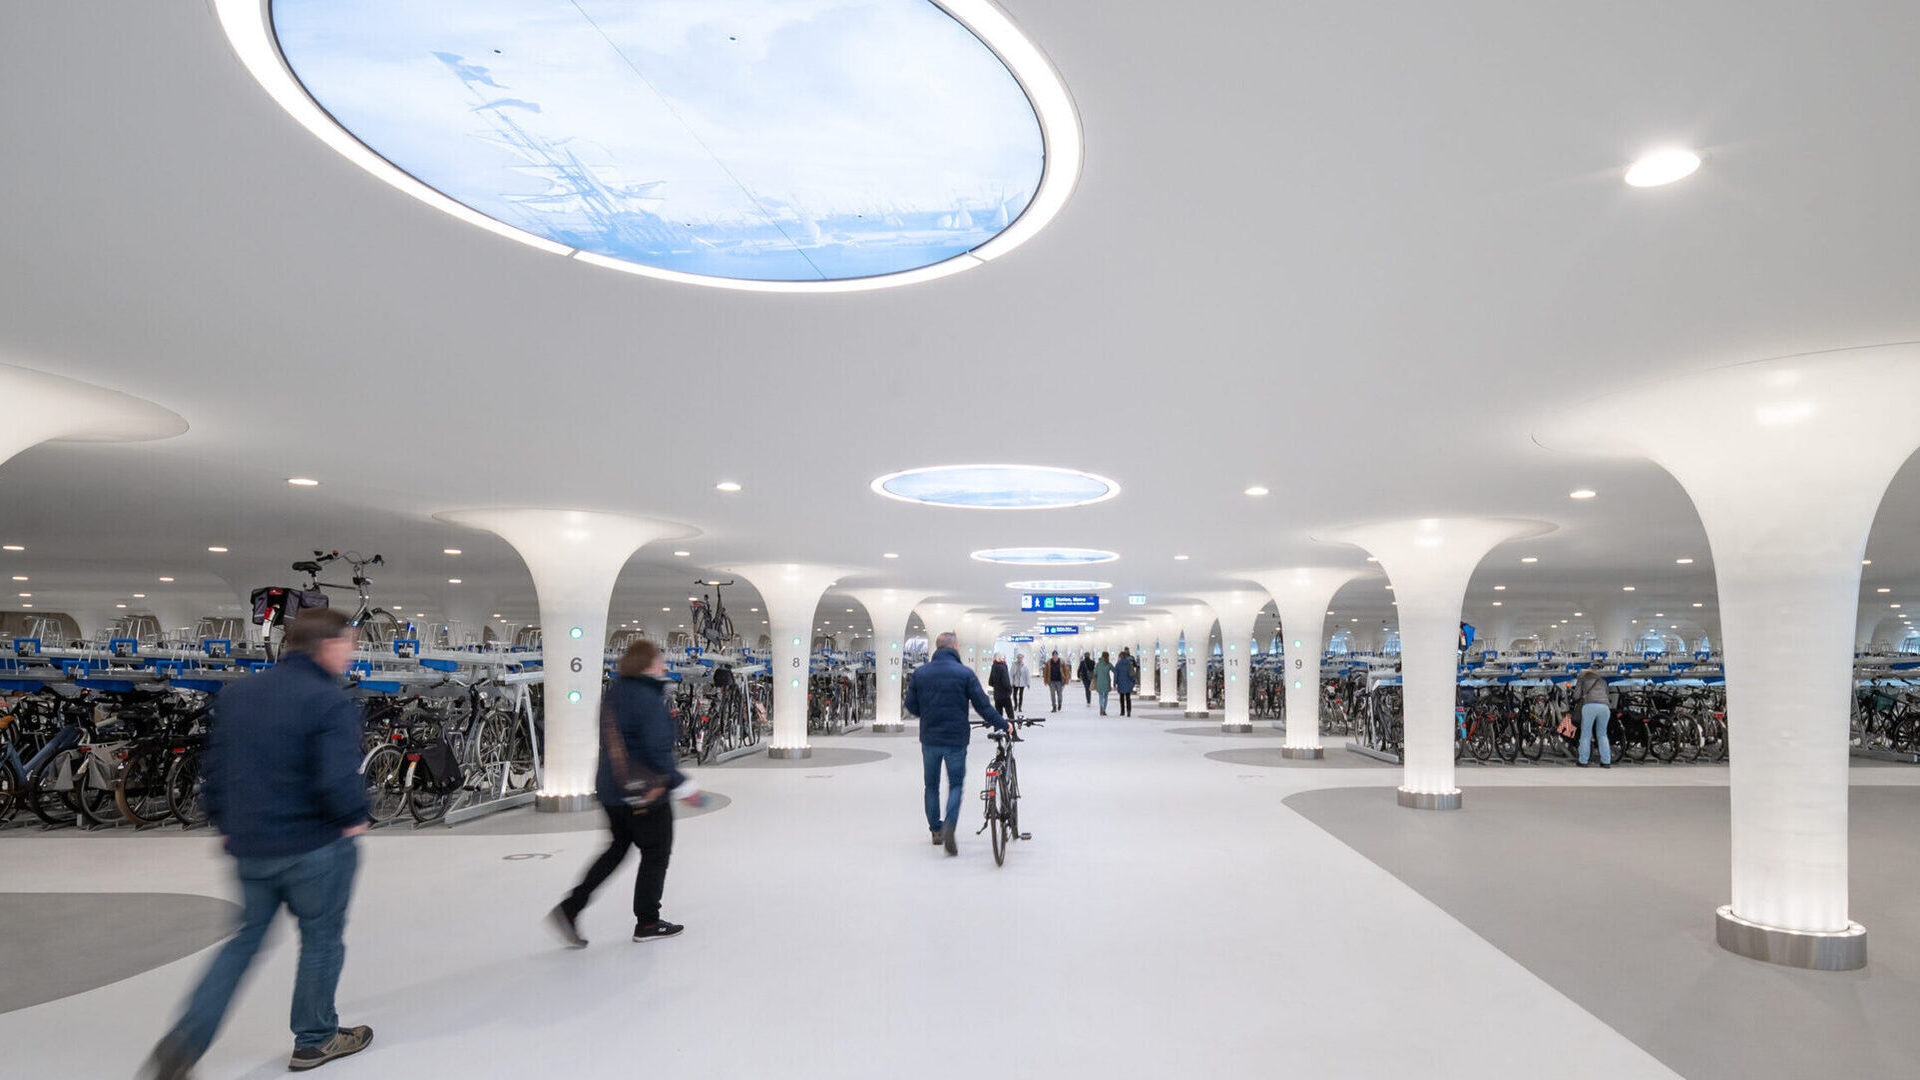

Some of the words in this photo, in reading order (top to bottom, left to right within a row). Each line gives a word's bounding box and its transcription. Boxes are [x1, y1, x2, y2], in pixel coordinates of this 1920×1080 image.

[570, 657, 582, 673] 6
[792, 657, 800, 668] 8
[890, 657, 899, 666] 10
[1229, 658, 1238, 666] 11
[1295, 659, 1302, 670] 9
